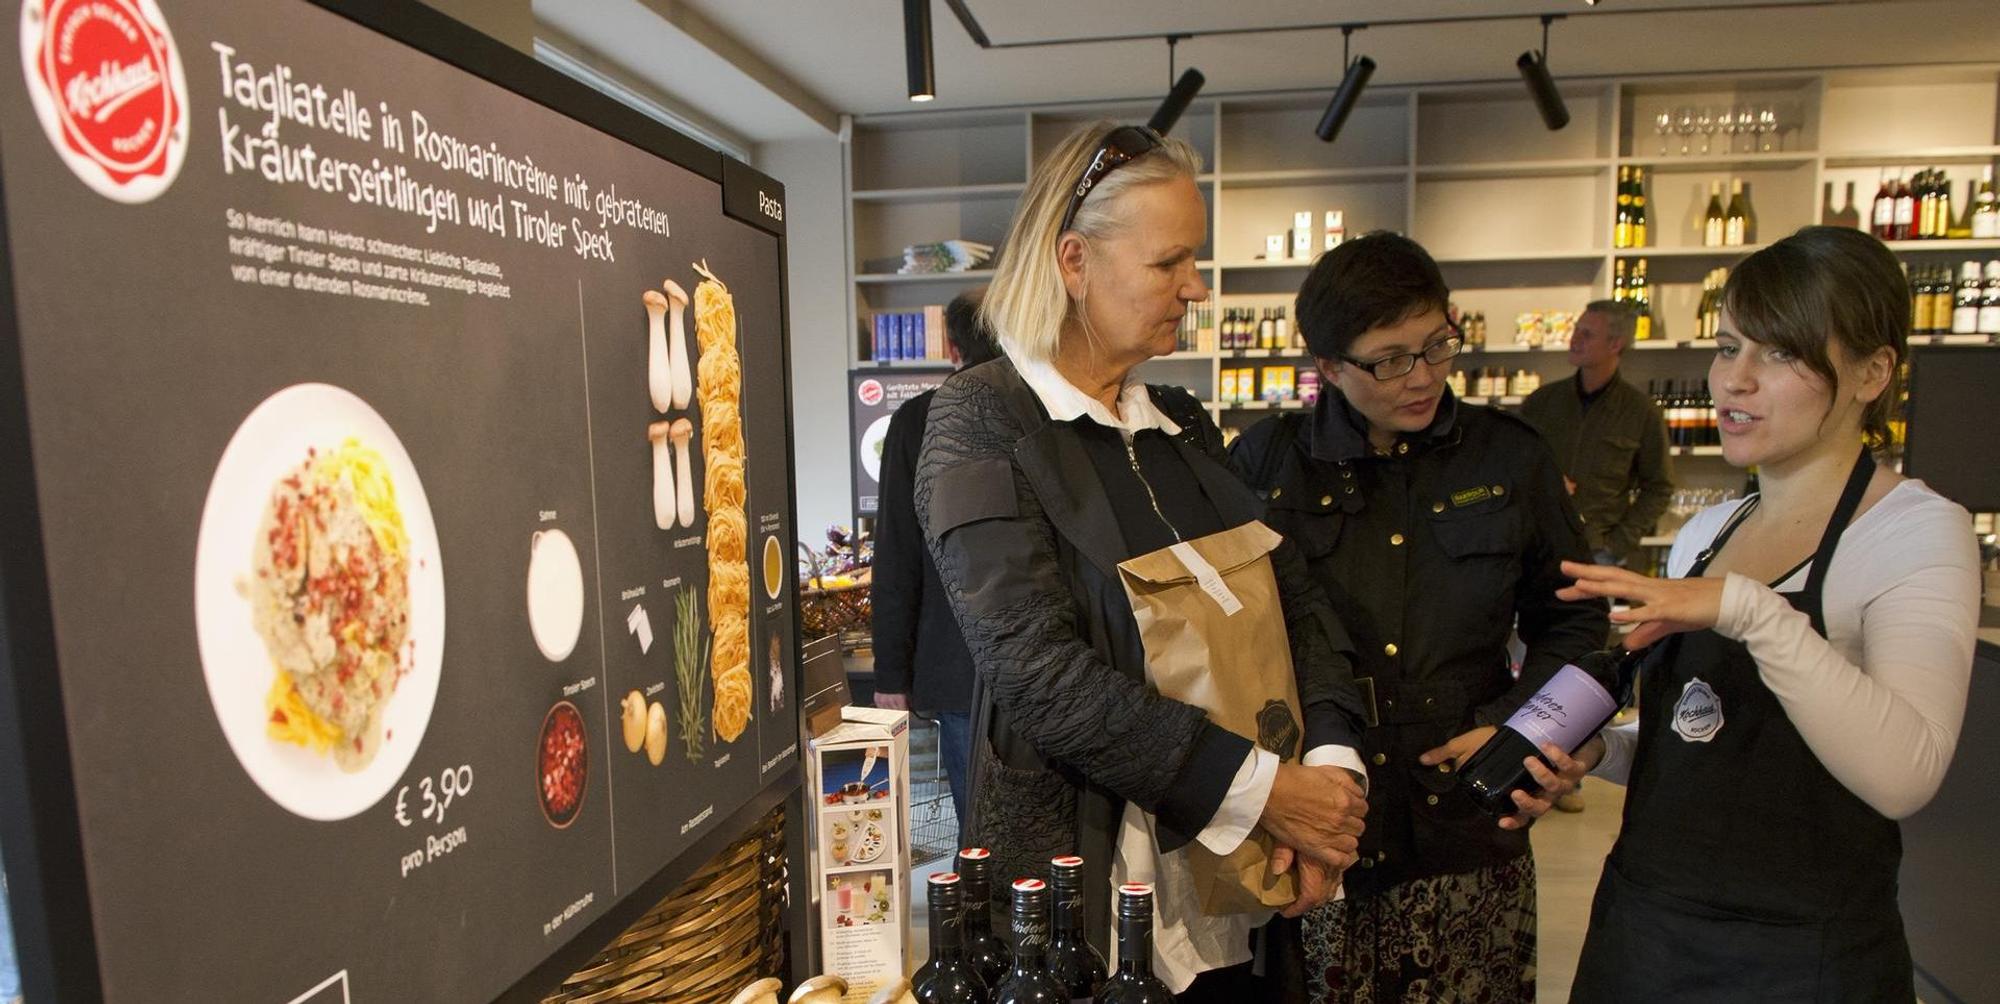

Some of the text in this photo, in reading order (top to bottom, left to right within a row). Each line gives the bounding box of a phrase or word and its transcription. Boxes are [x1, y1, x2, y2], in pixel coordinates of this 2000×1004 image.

[211, 41, 670, 238] Tagliatelle in Rosmarincrème mit gebratenen
[467, 193, 506, 238] und
[511, 199, 566, 249] Tiroler
[571, 219, 615, 264] Speck
[759, 190, 782, 221] Pasta
[226, 208, 246, 230] So
[246, 211, 297, 239] herrlich
[328, 229, 366, 252] Herbst
[231, 264, 258, 283] von
[258, 265, 292, 288] einer
[293, 271, 352, 296] duftenden
[287, 245, 326, 268] Tiroler
[327, 252, 361, 273] Speck
[361, 261, 382, 277] und
[383, 264, 409, 281] zarte
[394, 764, 473, 827] € 3,90
[401, 826, 467, 878] pro Person
